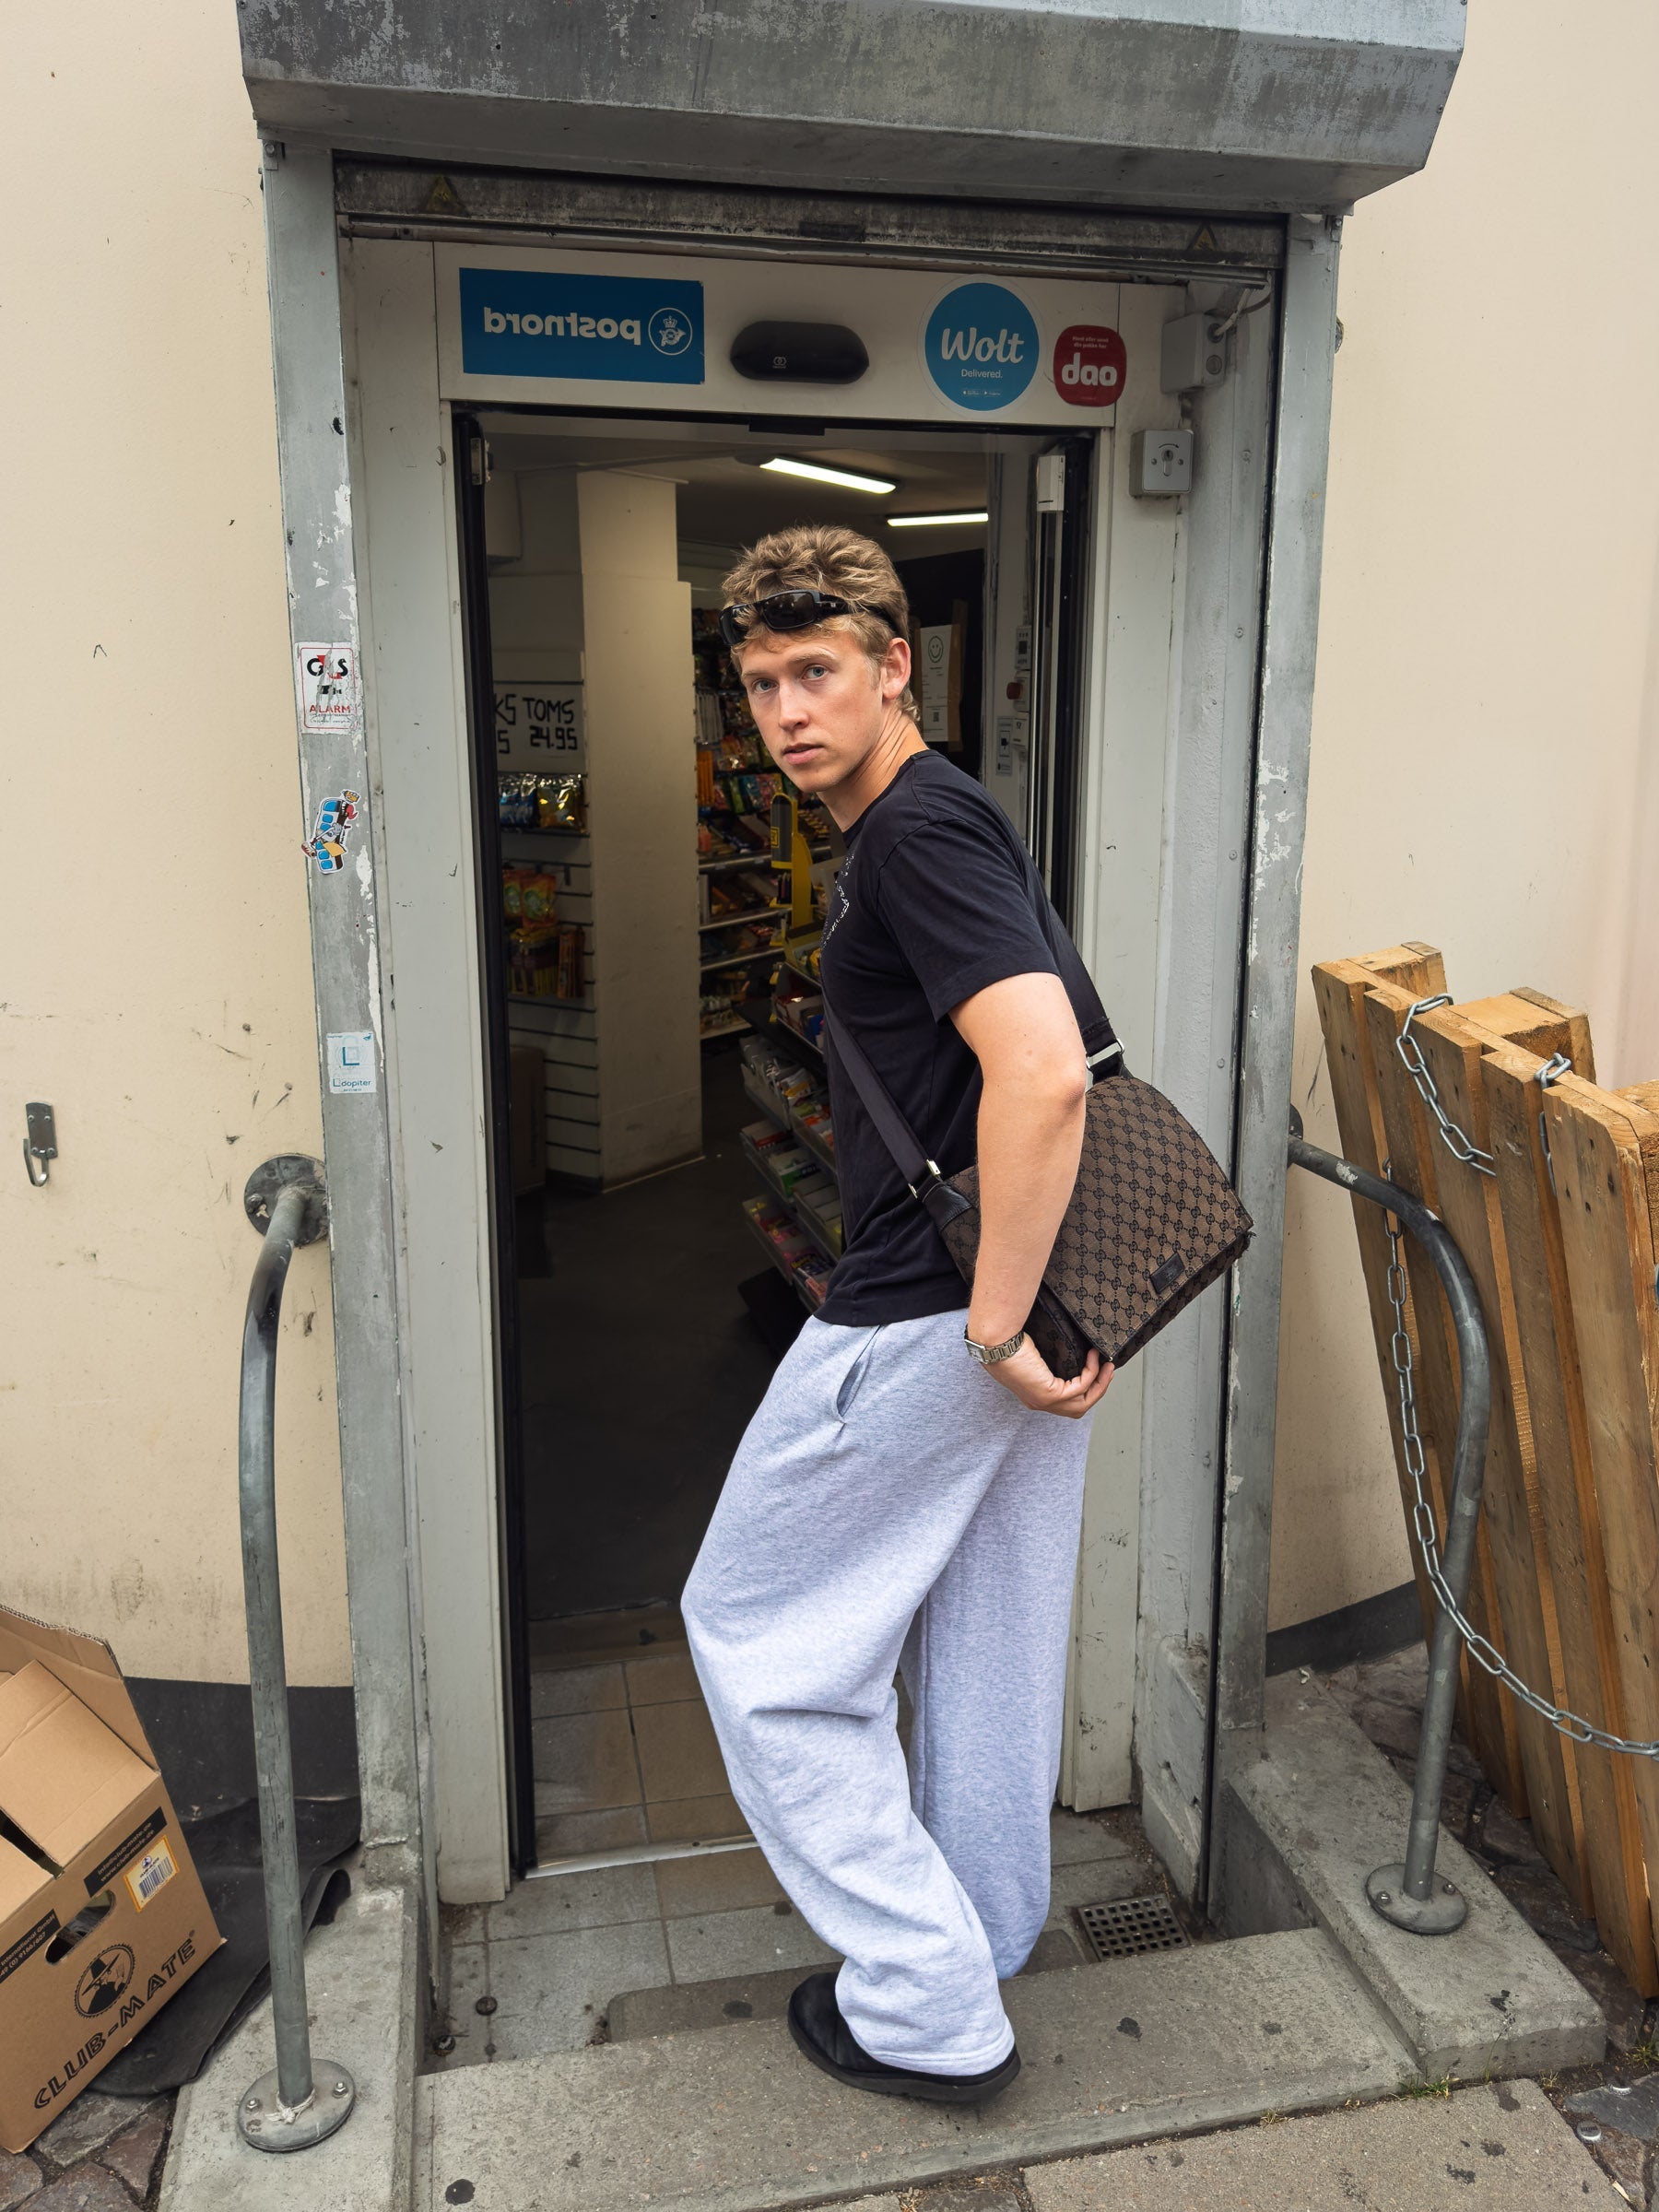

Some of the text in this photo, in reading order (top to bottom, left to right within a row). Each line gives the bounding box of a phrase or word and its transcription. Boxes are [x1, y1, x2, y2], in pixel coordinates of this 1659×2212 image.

[941, 327, 1025, 364] Wolt
[961, 369, 1003, 378] Delivered.
[1062, 352, 1117, 386] dao
[310, 704, 351, 713] ALARM
[522, 697, 574, 724] TOMS
[529, 725, 578, 750] 24.95
[34, 1938, 195, 2109] CLUB-MATE
